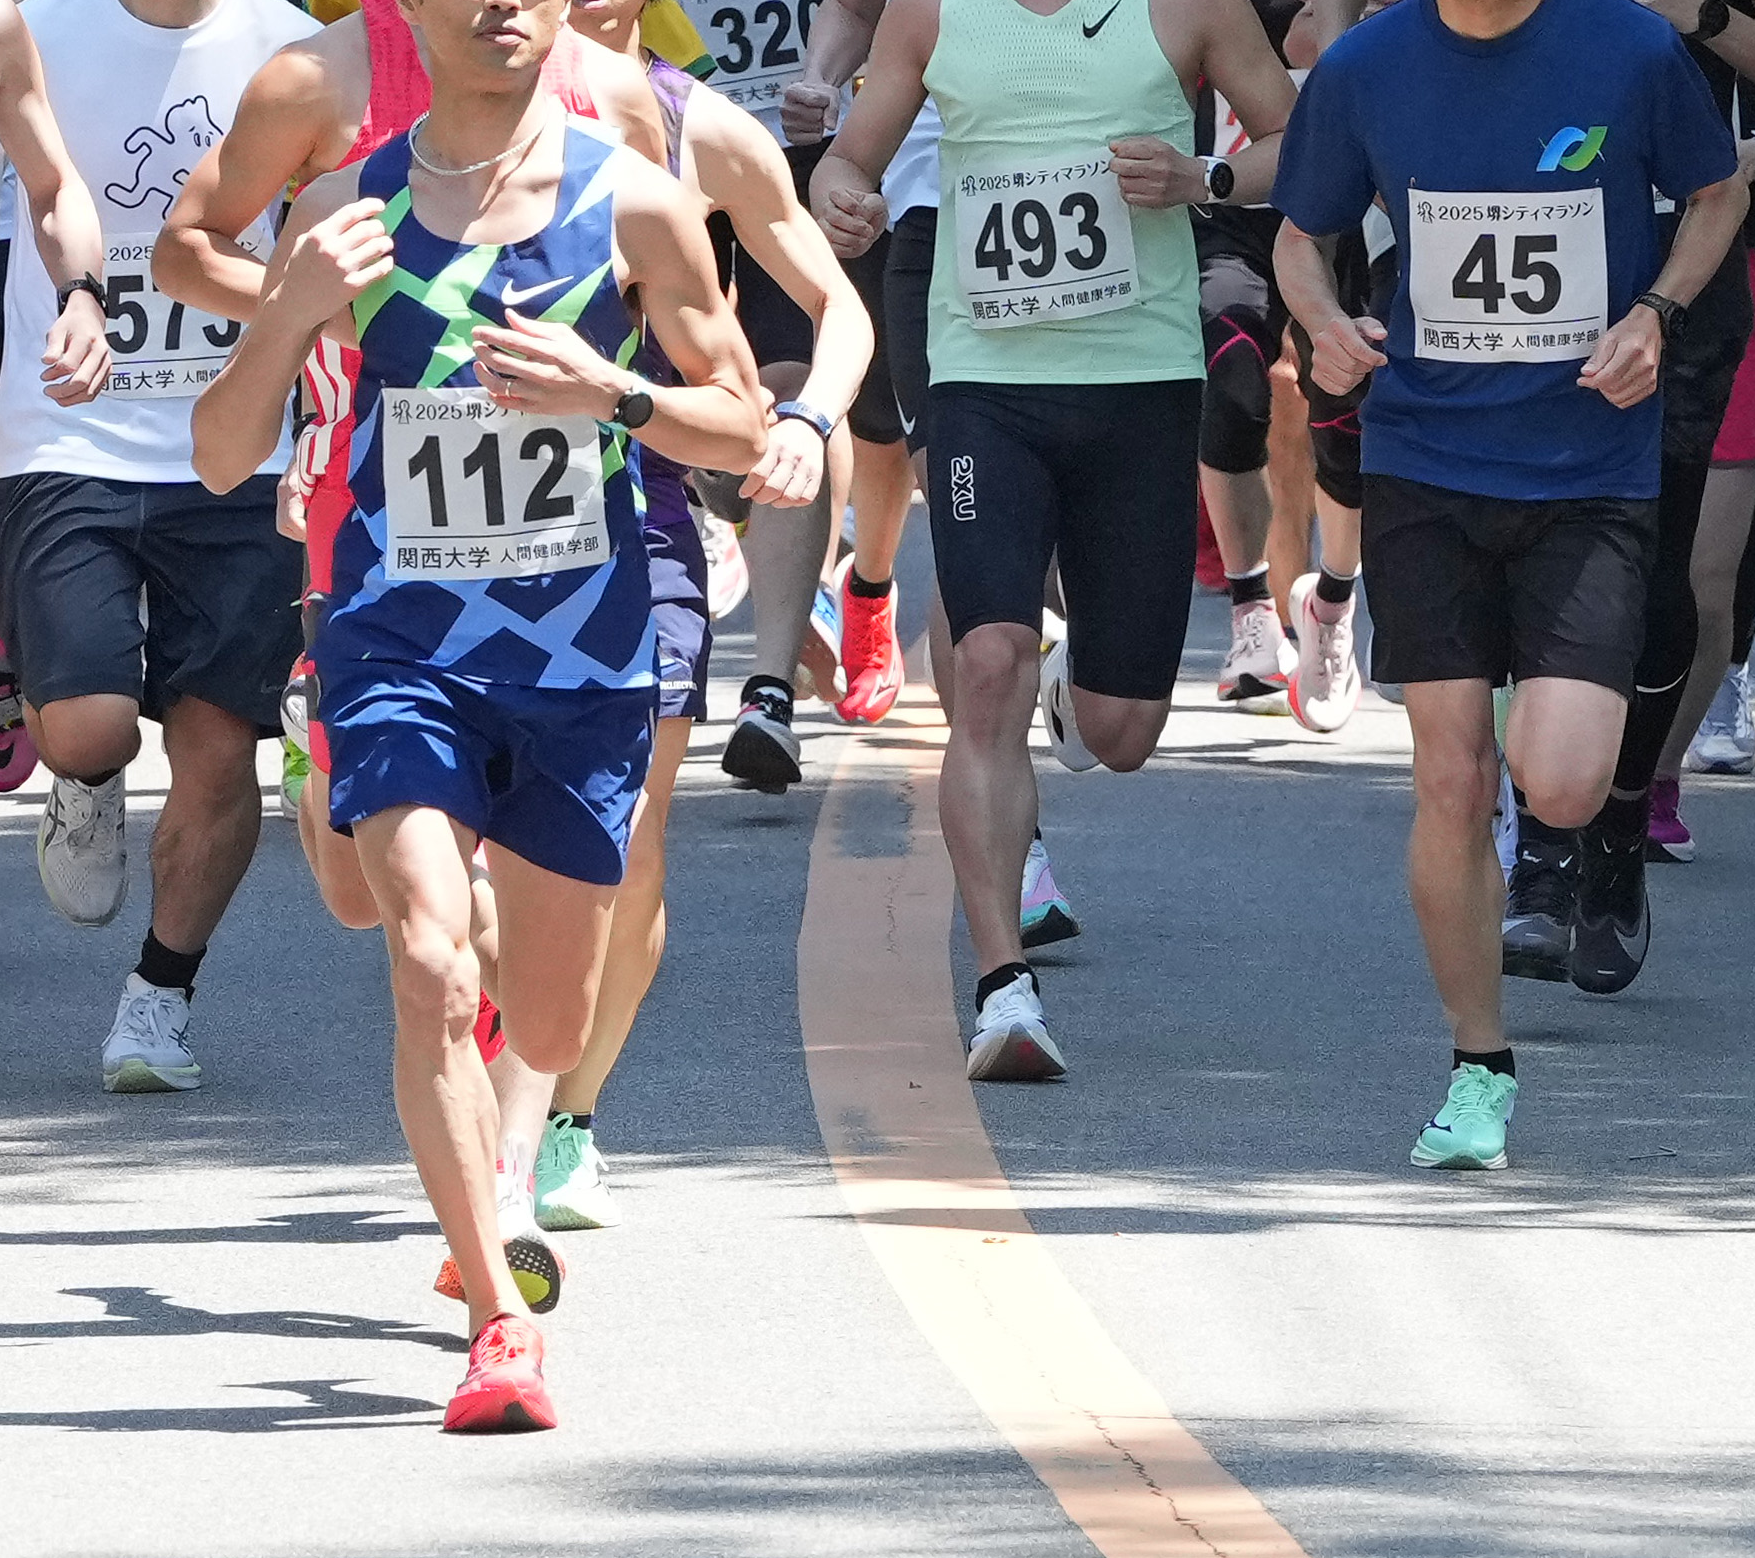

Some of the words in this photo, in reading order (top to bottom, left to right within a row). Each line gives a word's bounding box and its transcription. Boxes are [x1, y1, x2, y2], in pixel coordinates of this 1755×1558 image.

[974, 192, 1108, 281] 493
[971, 295, 1041, 321] 関西大学
[1048, 281, 1132, 310] 人間健康学部
[1451, 233, 1562, 315] 45
[1424, 327, 1504, 351] 関西大学
[1511, 328, 1600, 349] 人間健康学部
[407, 427, 575, 528] 112
[950, 454, 977, 521] 2XU
[397, 546, 490, 570] 関西大学
[499, 536, 600, 564] 人間健康学部
